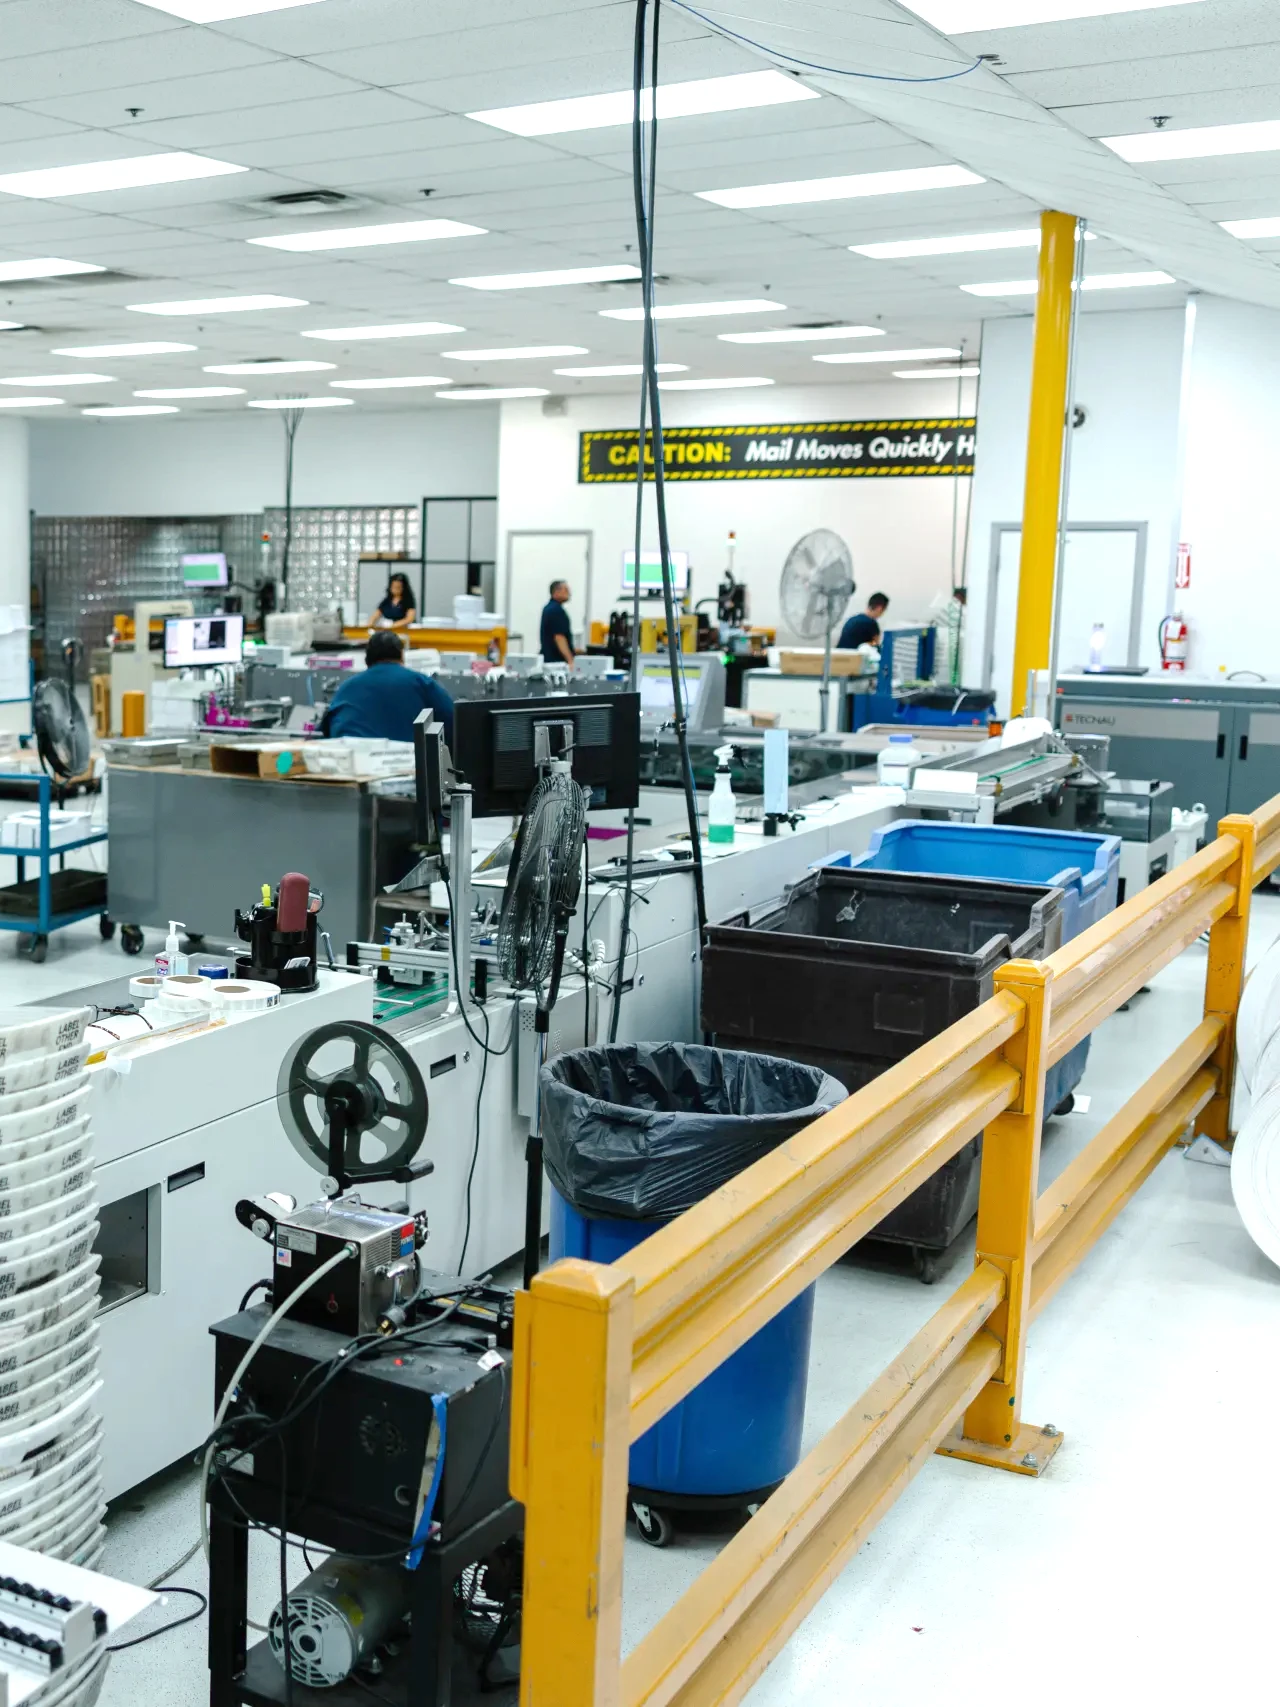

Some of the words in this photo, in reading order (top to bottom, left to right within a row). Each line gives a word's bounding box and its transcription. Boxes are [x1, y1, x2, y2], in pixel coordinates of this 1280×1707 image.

[608, 441, 732, 466] CAUTION:
[744, 437, 793, 462] Mail
[795, 438, 863, 461] Moves
[868, 432, 954, 463] Quickly
[956, 434, 976, 456] H
[58, 1019, 80, 1035] LABEL
[57, 1055, 80, 1069] LABEL
